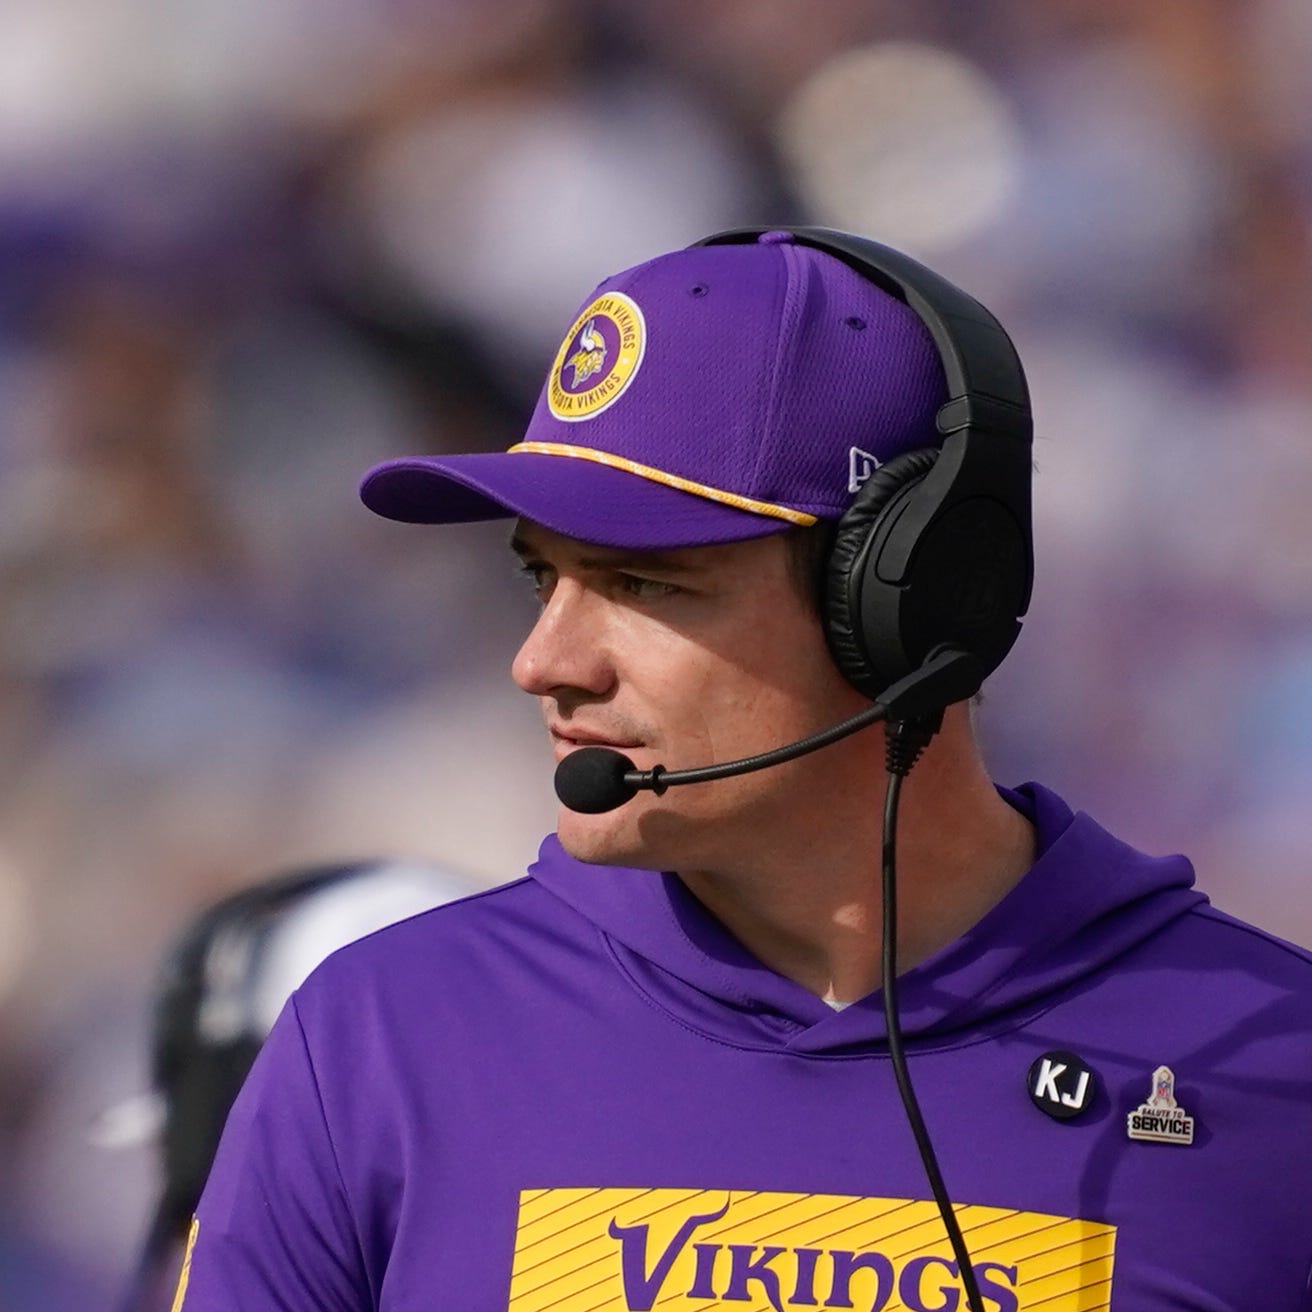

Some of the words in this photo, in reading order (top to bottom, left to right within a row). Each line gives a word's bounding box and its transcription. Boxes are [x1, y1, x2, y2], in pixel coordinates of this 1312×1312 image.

[577, 373, 621, 408] VIKINGS
[1035, 1059, 1090, 1110] KJ
[1132, 1116, 1191, 1136] SERVICE
[1141, 1108, 1171, 1118] SALUTE
[1172, 1110, 1183, 1119] TO
